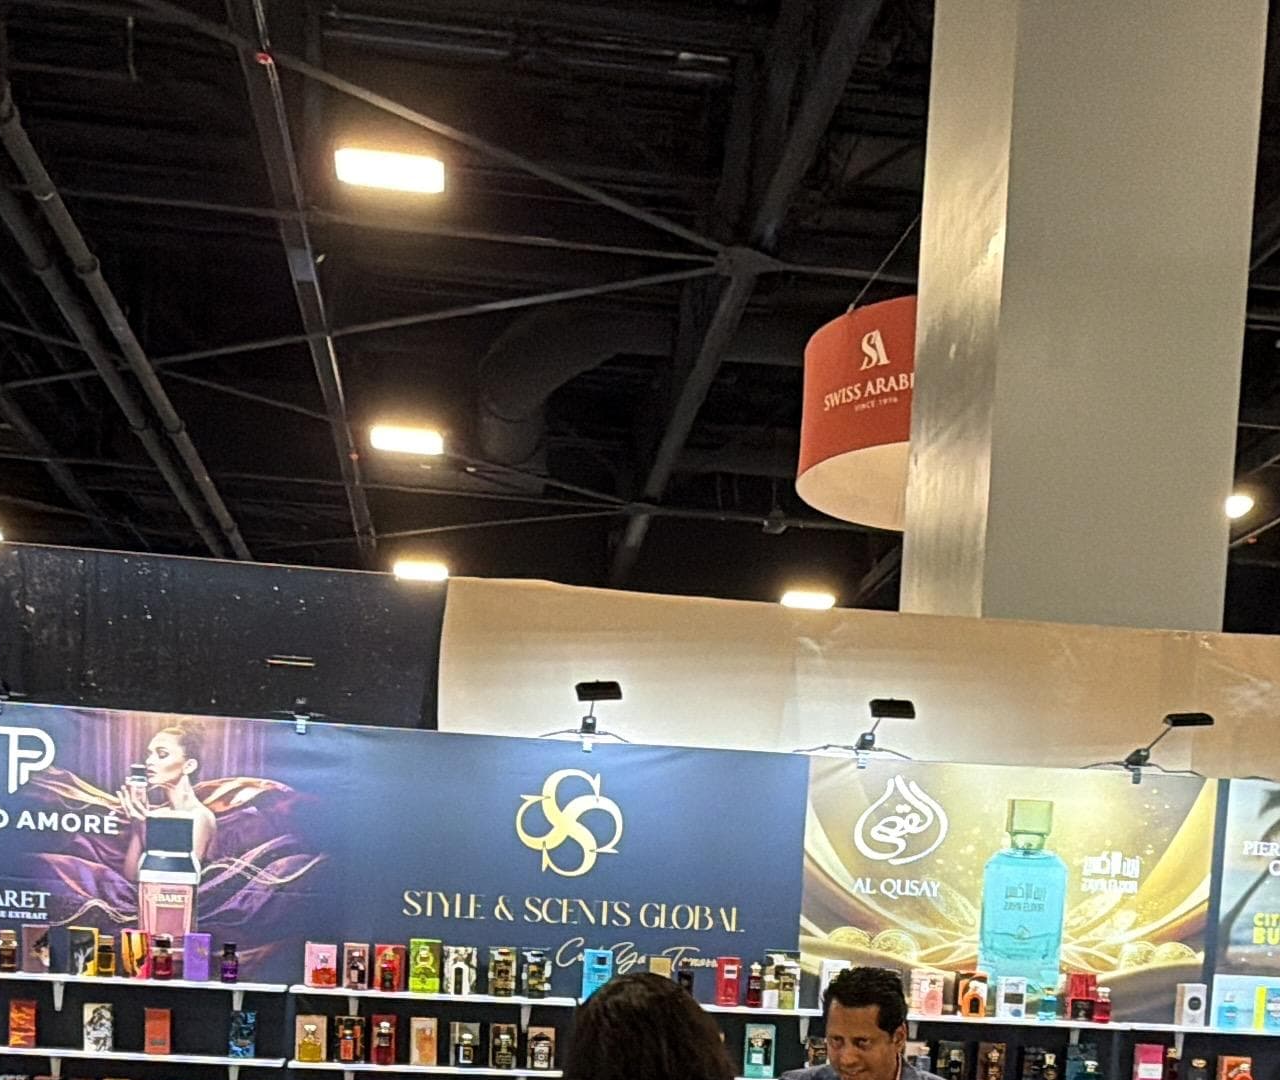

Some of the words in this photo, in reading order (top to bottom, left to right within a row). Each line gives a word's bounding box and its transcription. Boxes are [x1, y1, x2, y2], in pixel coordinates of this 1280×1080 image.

[823, 382, 862, 412] SWISS
[863, 372, 915, 398] ARABI
[16, 810, 121, 836] AMORÉ
[851, 877, 877, 895] AL
[879, 877, 941, 900] QUSAY
[402, 889, 486, 920] STYLE
[494, 894, 515, 922] &
[523, 895, 632, 928] SCENTS
[638, 902, 746, 933] GLOBAL
